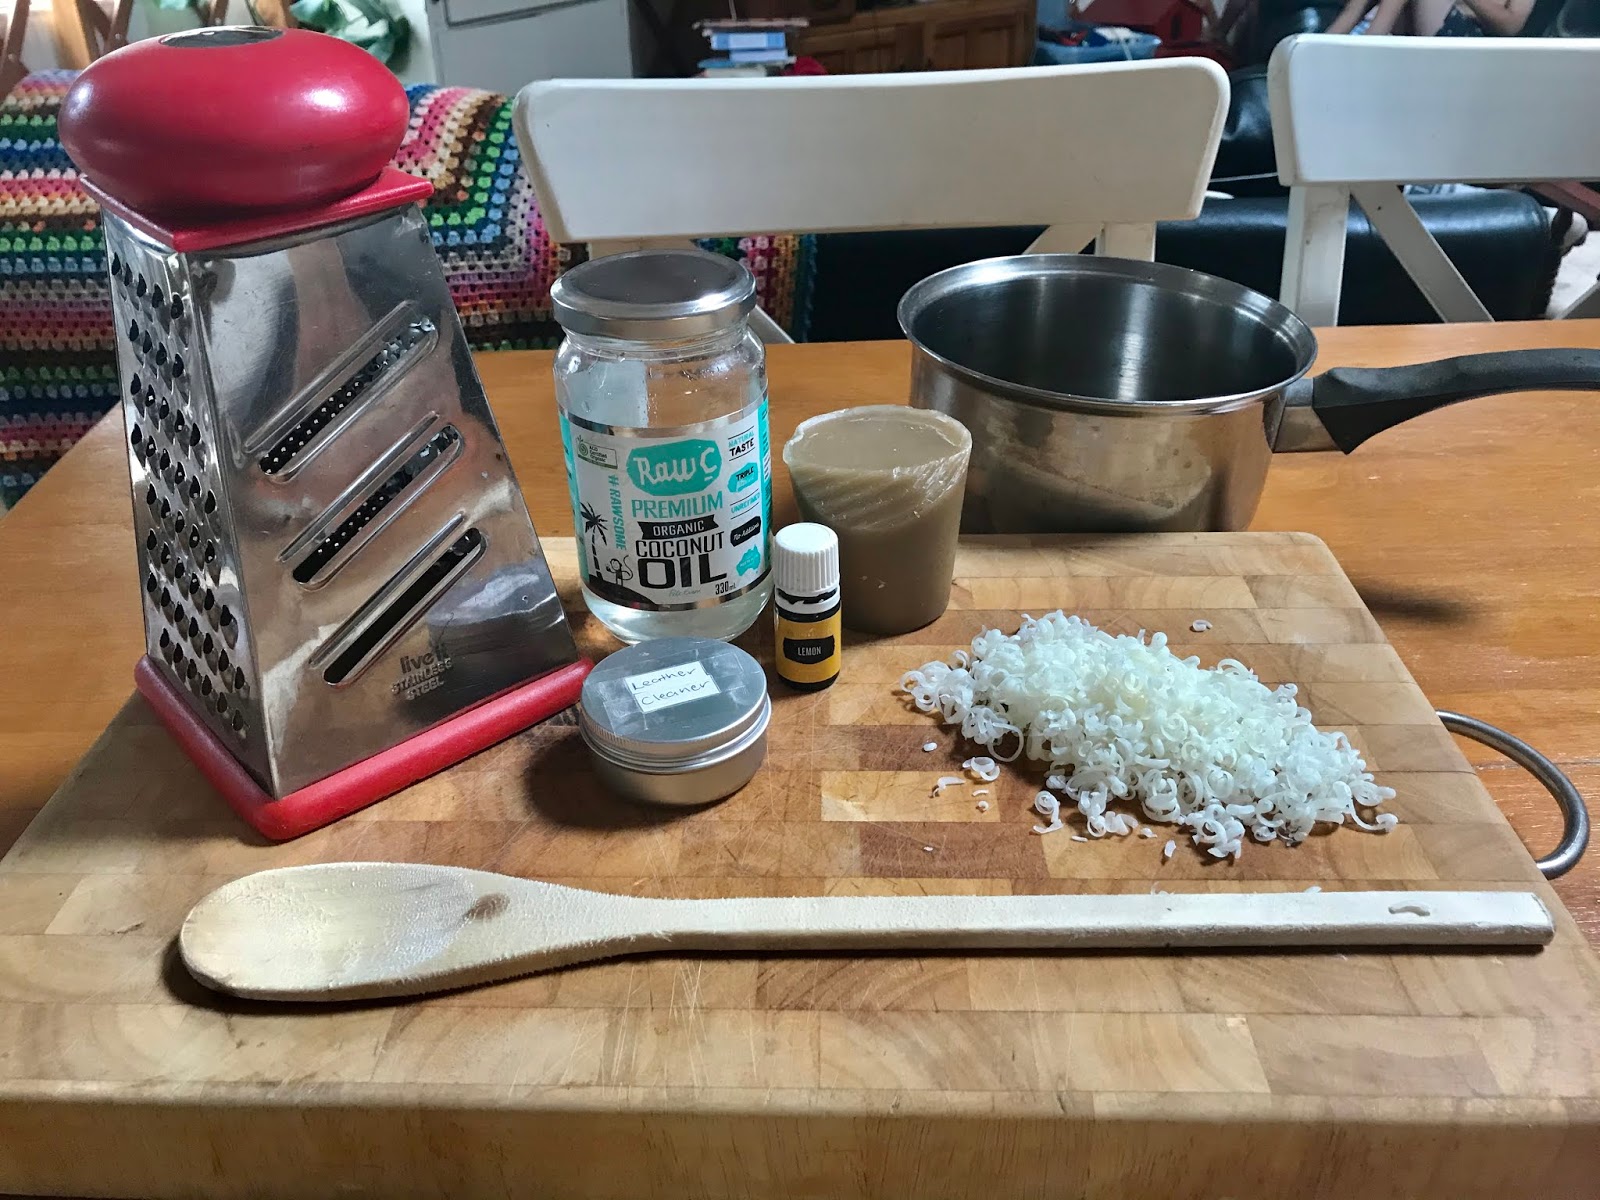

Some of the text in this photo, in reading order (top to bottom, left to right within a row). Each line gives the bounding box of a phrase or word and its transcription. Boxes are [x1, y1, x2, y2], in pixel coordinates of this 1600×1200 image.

[729, 437, 754, 456] TASTE
[631, 490, 723, 519] PREMIUM
[652, 520, 705, 537] ORGANIC
[635, 530, 725, 558] COCONUT
[637, 553, 728, 589] OIL
[400, 653, 434, 674] live
[797, 646, 822, 657] LEMON
[391, 657, 452, 695] STAINLESS
[406, 676, 445, 700] STEEL
[631, 667, 697, 691] Leather
[641, 680, 710, 706] Cleaner
